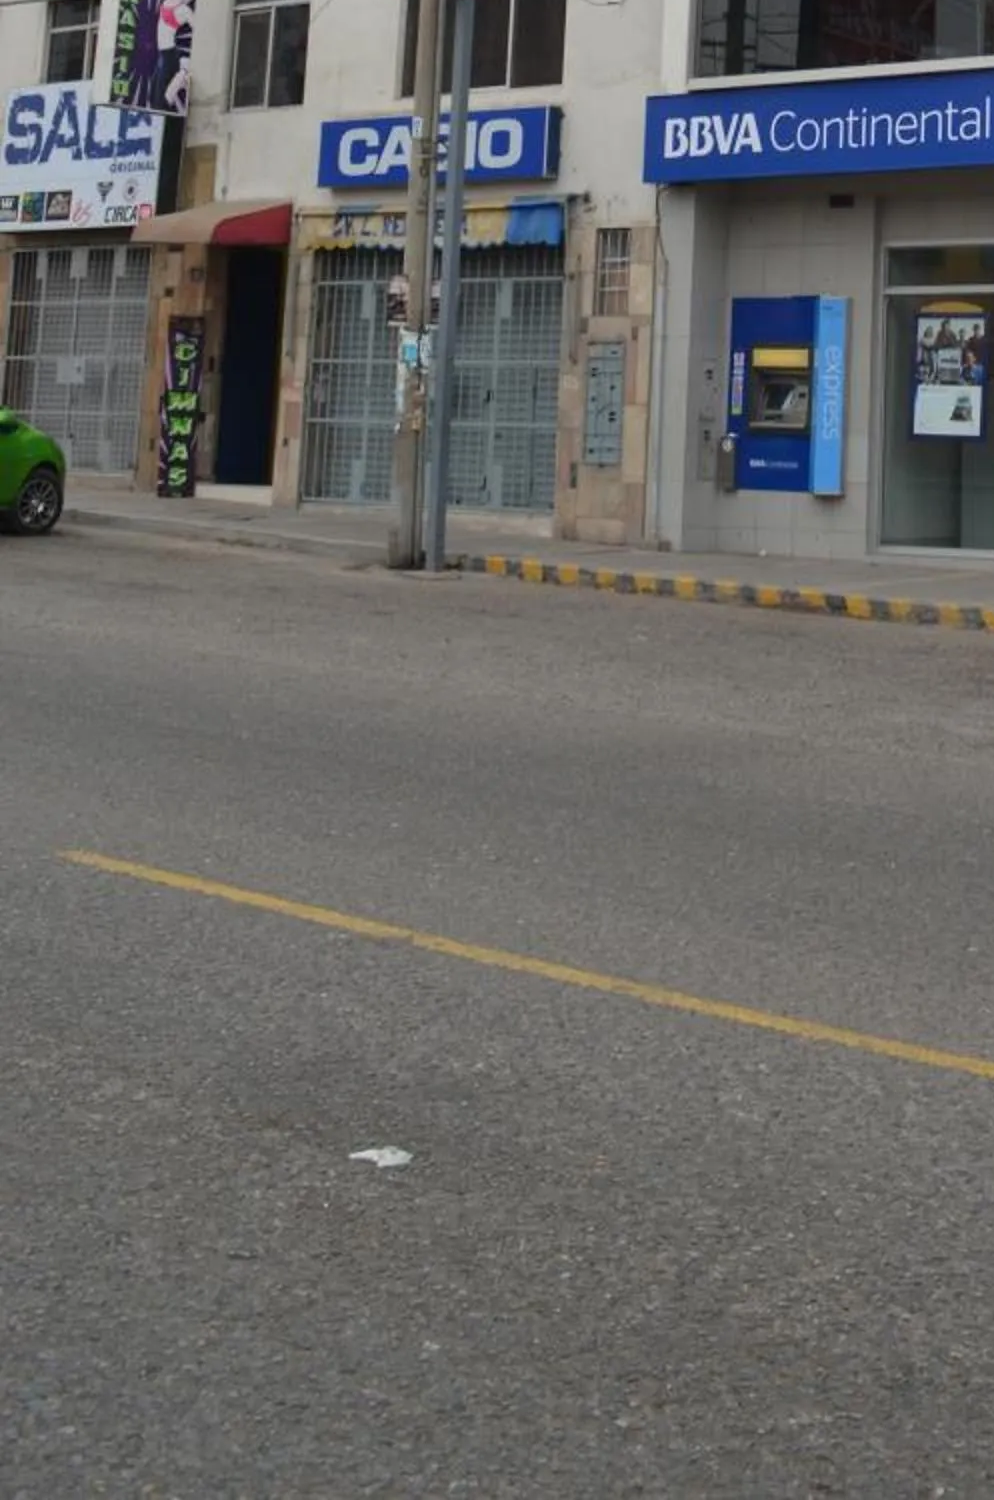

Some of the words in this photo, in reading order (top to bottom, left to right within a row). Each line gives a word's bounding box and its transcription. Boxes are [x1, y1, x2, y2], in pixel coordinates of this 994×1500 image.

[5, 90, 152, 166] SALE
[663, 112, 762, 159] BBVA
[769, 95, 992, 153] Continental
